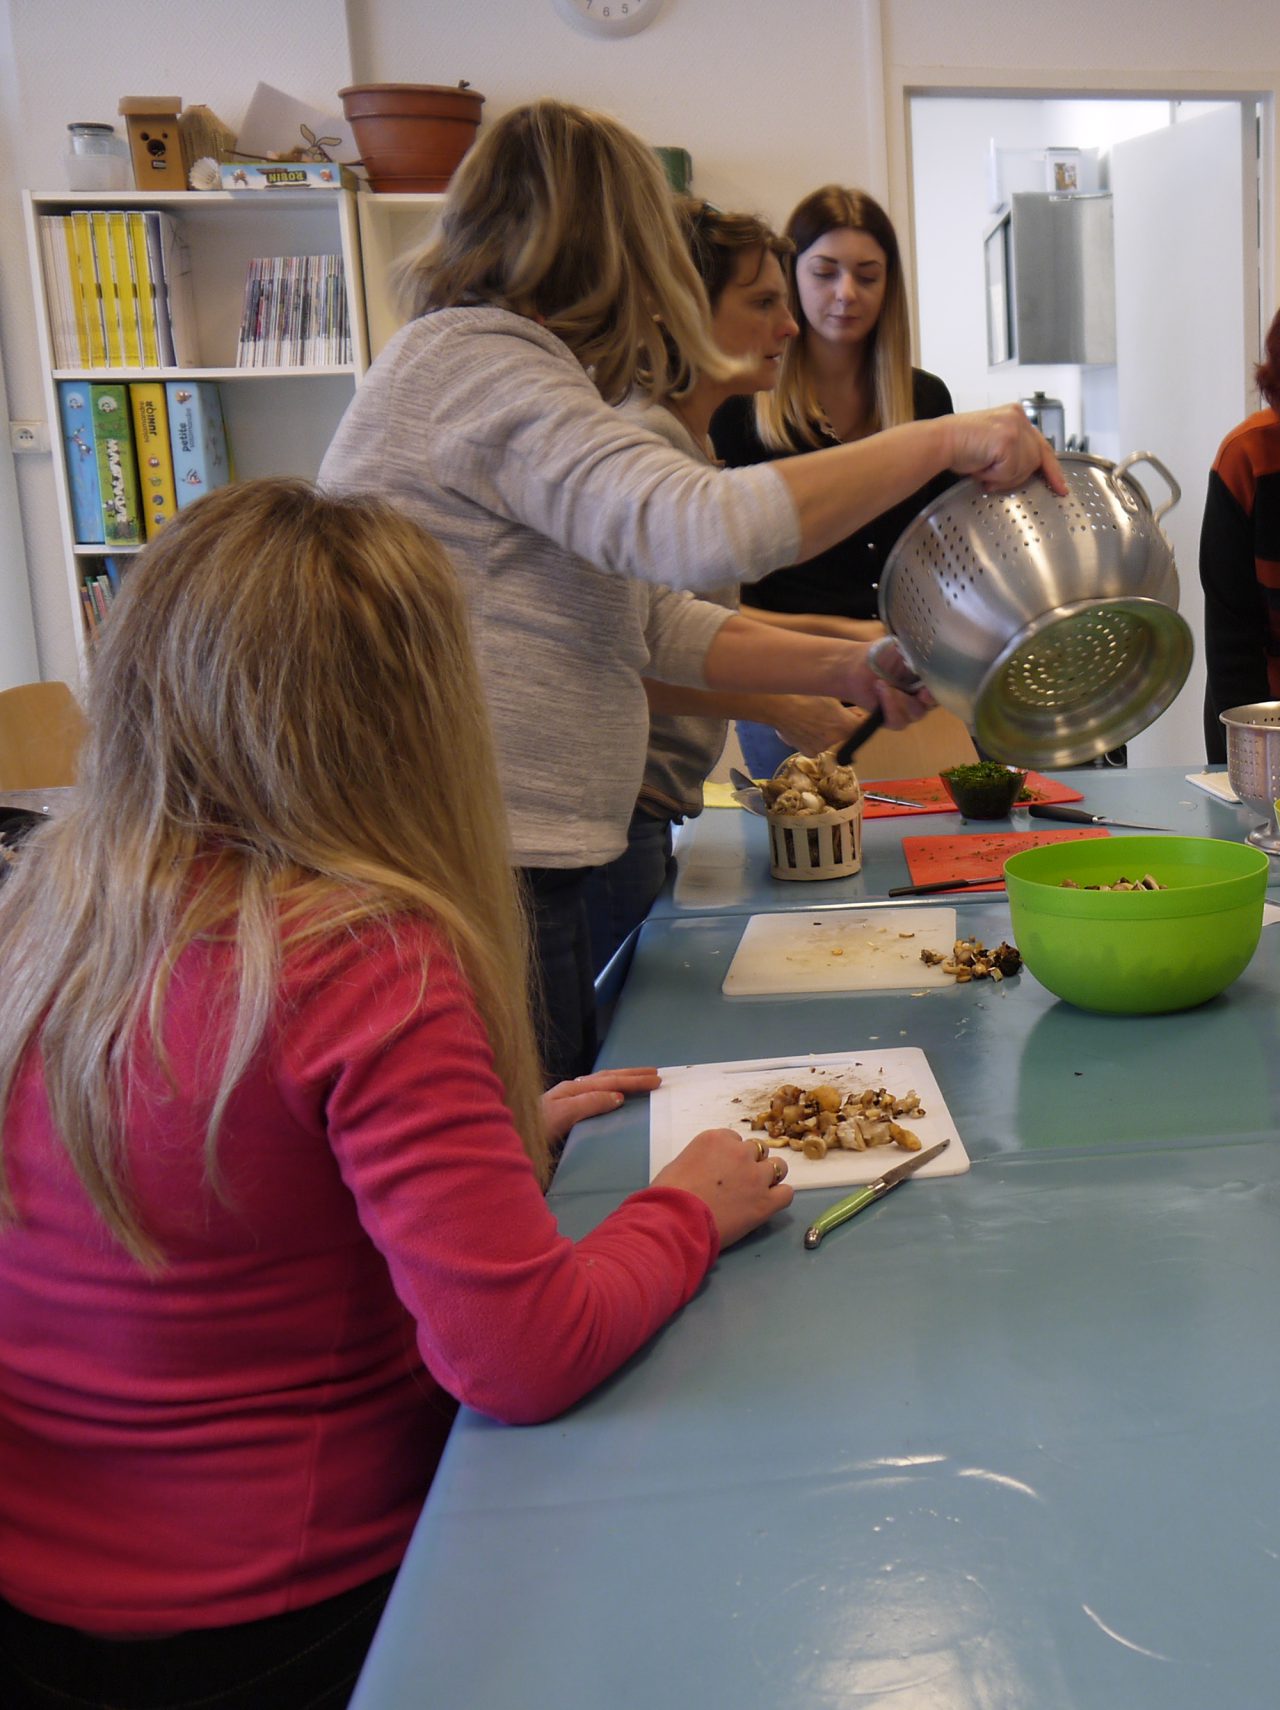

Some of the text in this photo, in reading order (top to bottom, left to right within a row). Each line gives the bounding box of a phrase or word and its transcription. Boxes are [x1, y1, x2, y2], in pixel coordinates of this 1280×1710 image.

[603, 6, 610, 17] 6
[622, 3, 629, 14] 5
[269, 172, 305, 181] ROBIN
[179, 423, 191, 452] petite
